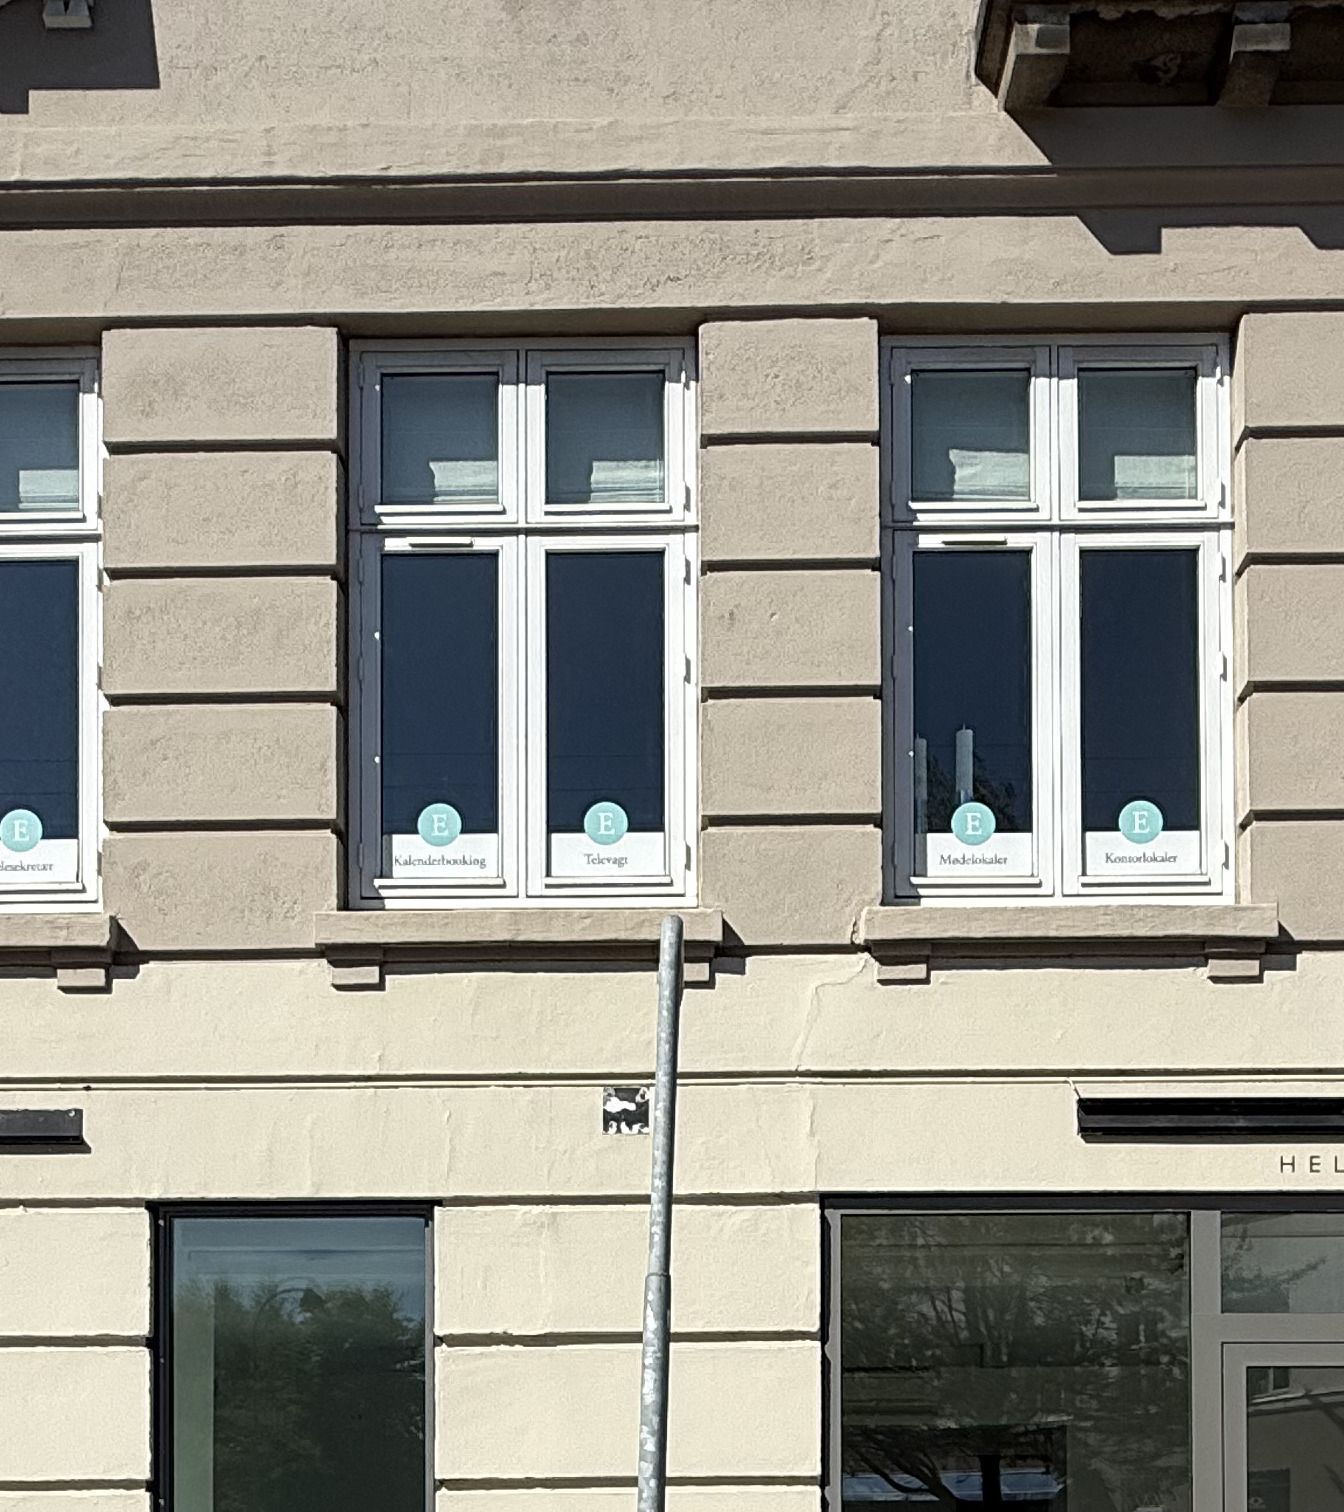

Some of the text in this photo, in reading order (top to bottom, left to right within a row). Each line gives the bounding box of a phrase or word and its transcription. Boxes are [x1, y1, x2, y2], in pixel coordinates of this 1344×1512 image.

[12, 819, 30, 841] E
[431, 814, 449, 836] E
[597, 812, 615, 835] E
[964, 812, 983, 835] E
[1132, 811, 1150, 833] E
[394, 853, 487, 869] Kalenderbooking
[584, 853, 629, 866] Televagt
[939, 853, 1008, 866] Mødelokaler
[1105, 852, 1178, 865] Kontorlokaler
